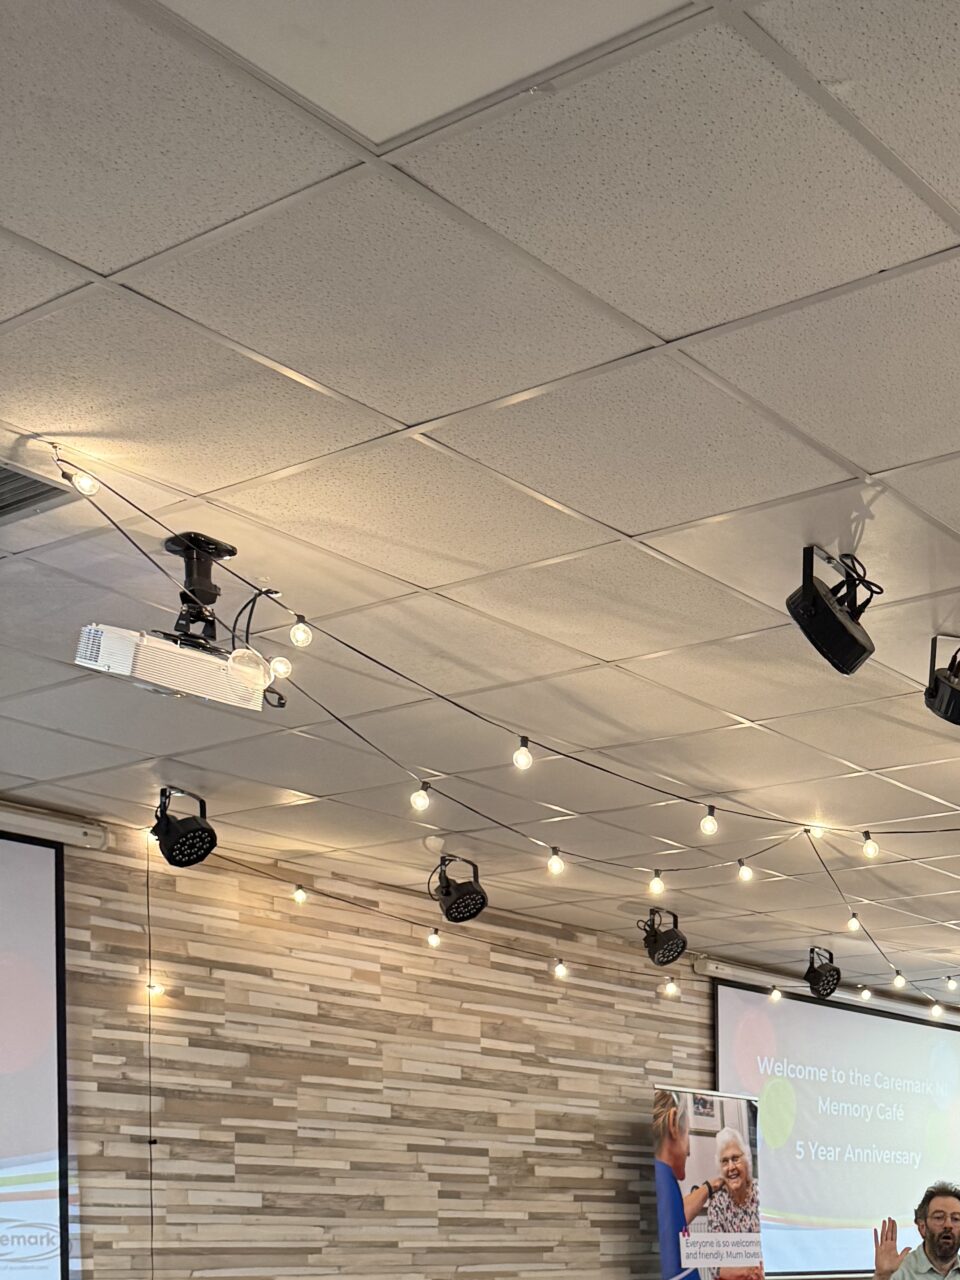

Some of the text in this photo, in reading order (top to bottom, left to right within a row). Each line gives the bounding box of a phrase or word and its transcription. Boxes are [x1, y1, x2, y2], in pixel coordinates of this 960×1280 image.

[757, 1055, 828, 1082] Welcome
[831, 1068, 846, 1084] to
[849, 1068, 871, 1087] the
[874, 1072, 933, 1096] Caremark
[818, 1096, 904, 1122] Memory Café
[795, 1141, 922, 1168] 5 Year Anniversary
[685, 1239, 714, 1250] Everyone
[715, 1239, 722, 1247] is
[685, 1251, 697, 1259] and
[726, 1251, 744, 1259] Mum
[744, 1250, 759, 1259] loves
